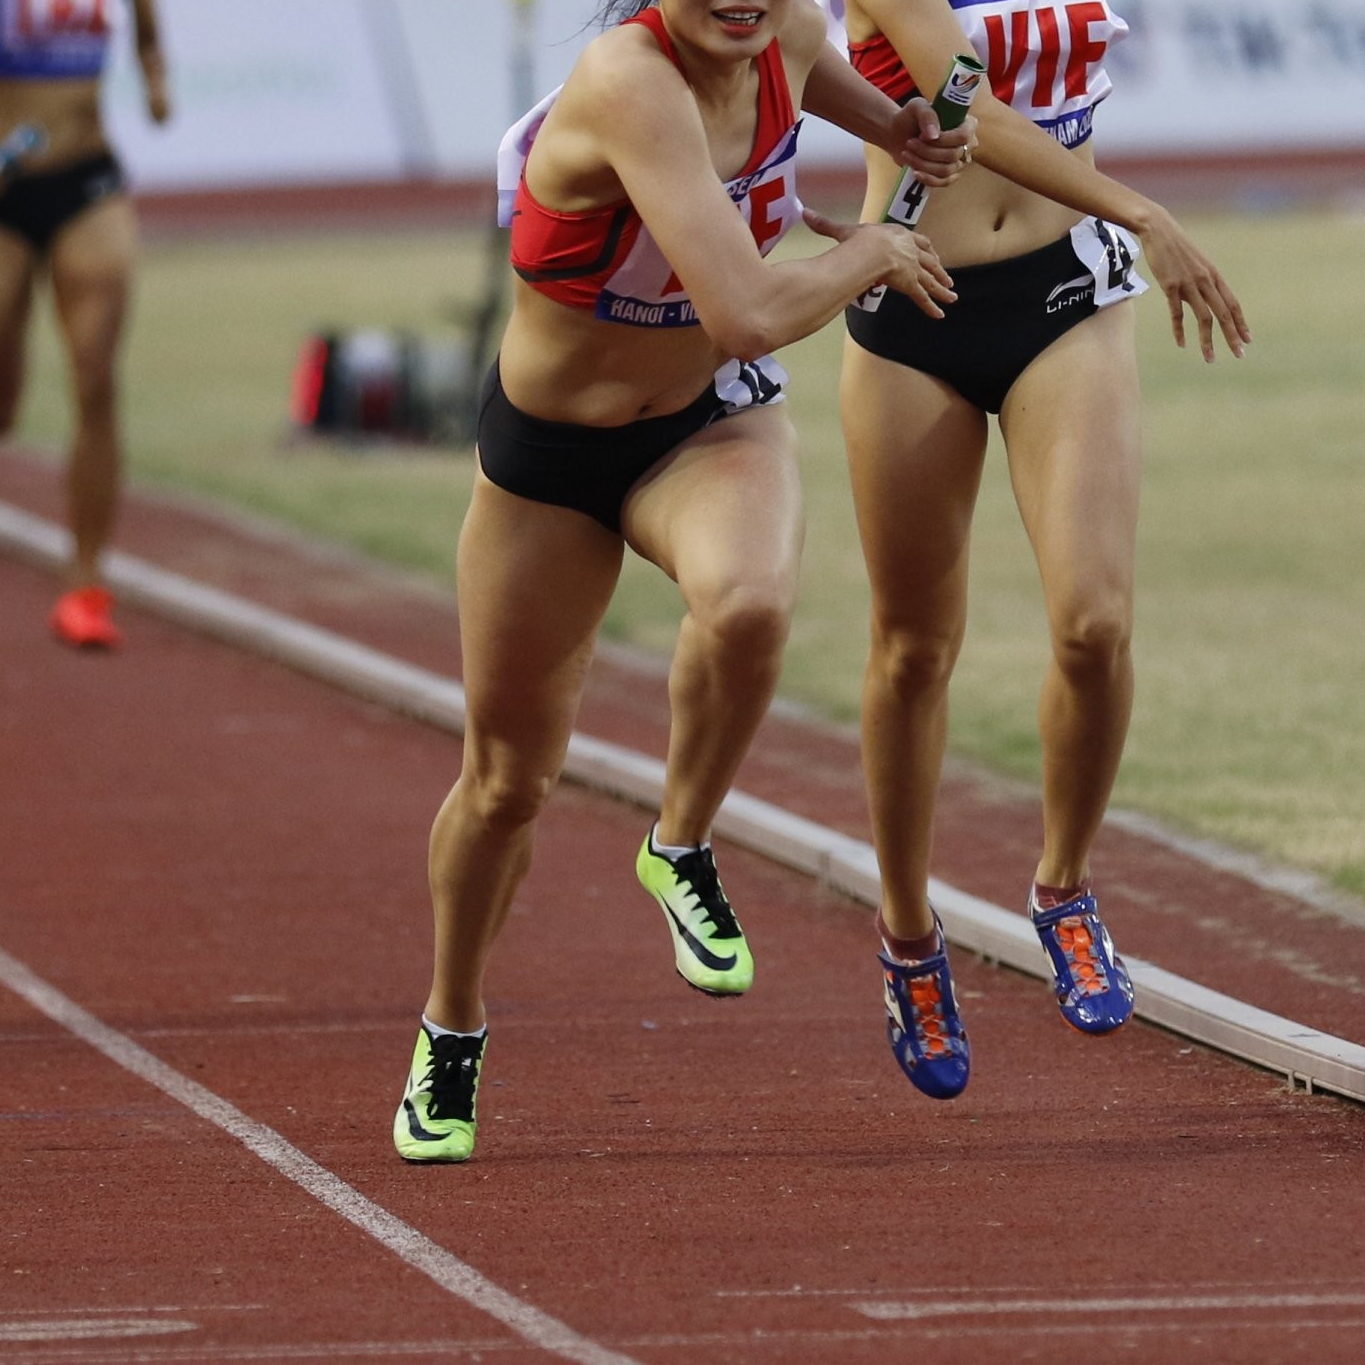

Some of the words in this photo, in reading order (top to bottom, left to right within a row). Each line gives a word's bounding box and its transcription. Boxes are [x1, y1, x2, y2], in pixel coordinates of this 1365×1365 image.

[903, 180, 925, 220] 4
[610, 298, 668, 324] HANOI
[1046, 286, 1094, 314] LI-NIN
